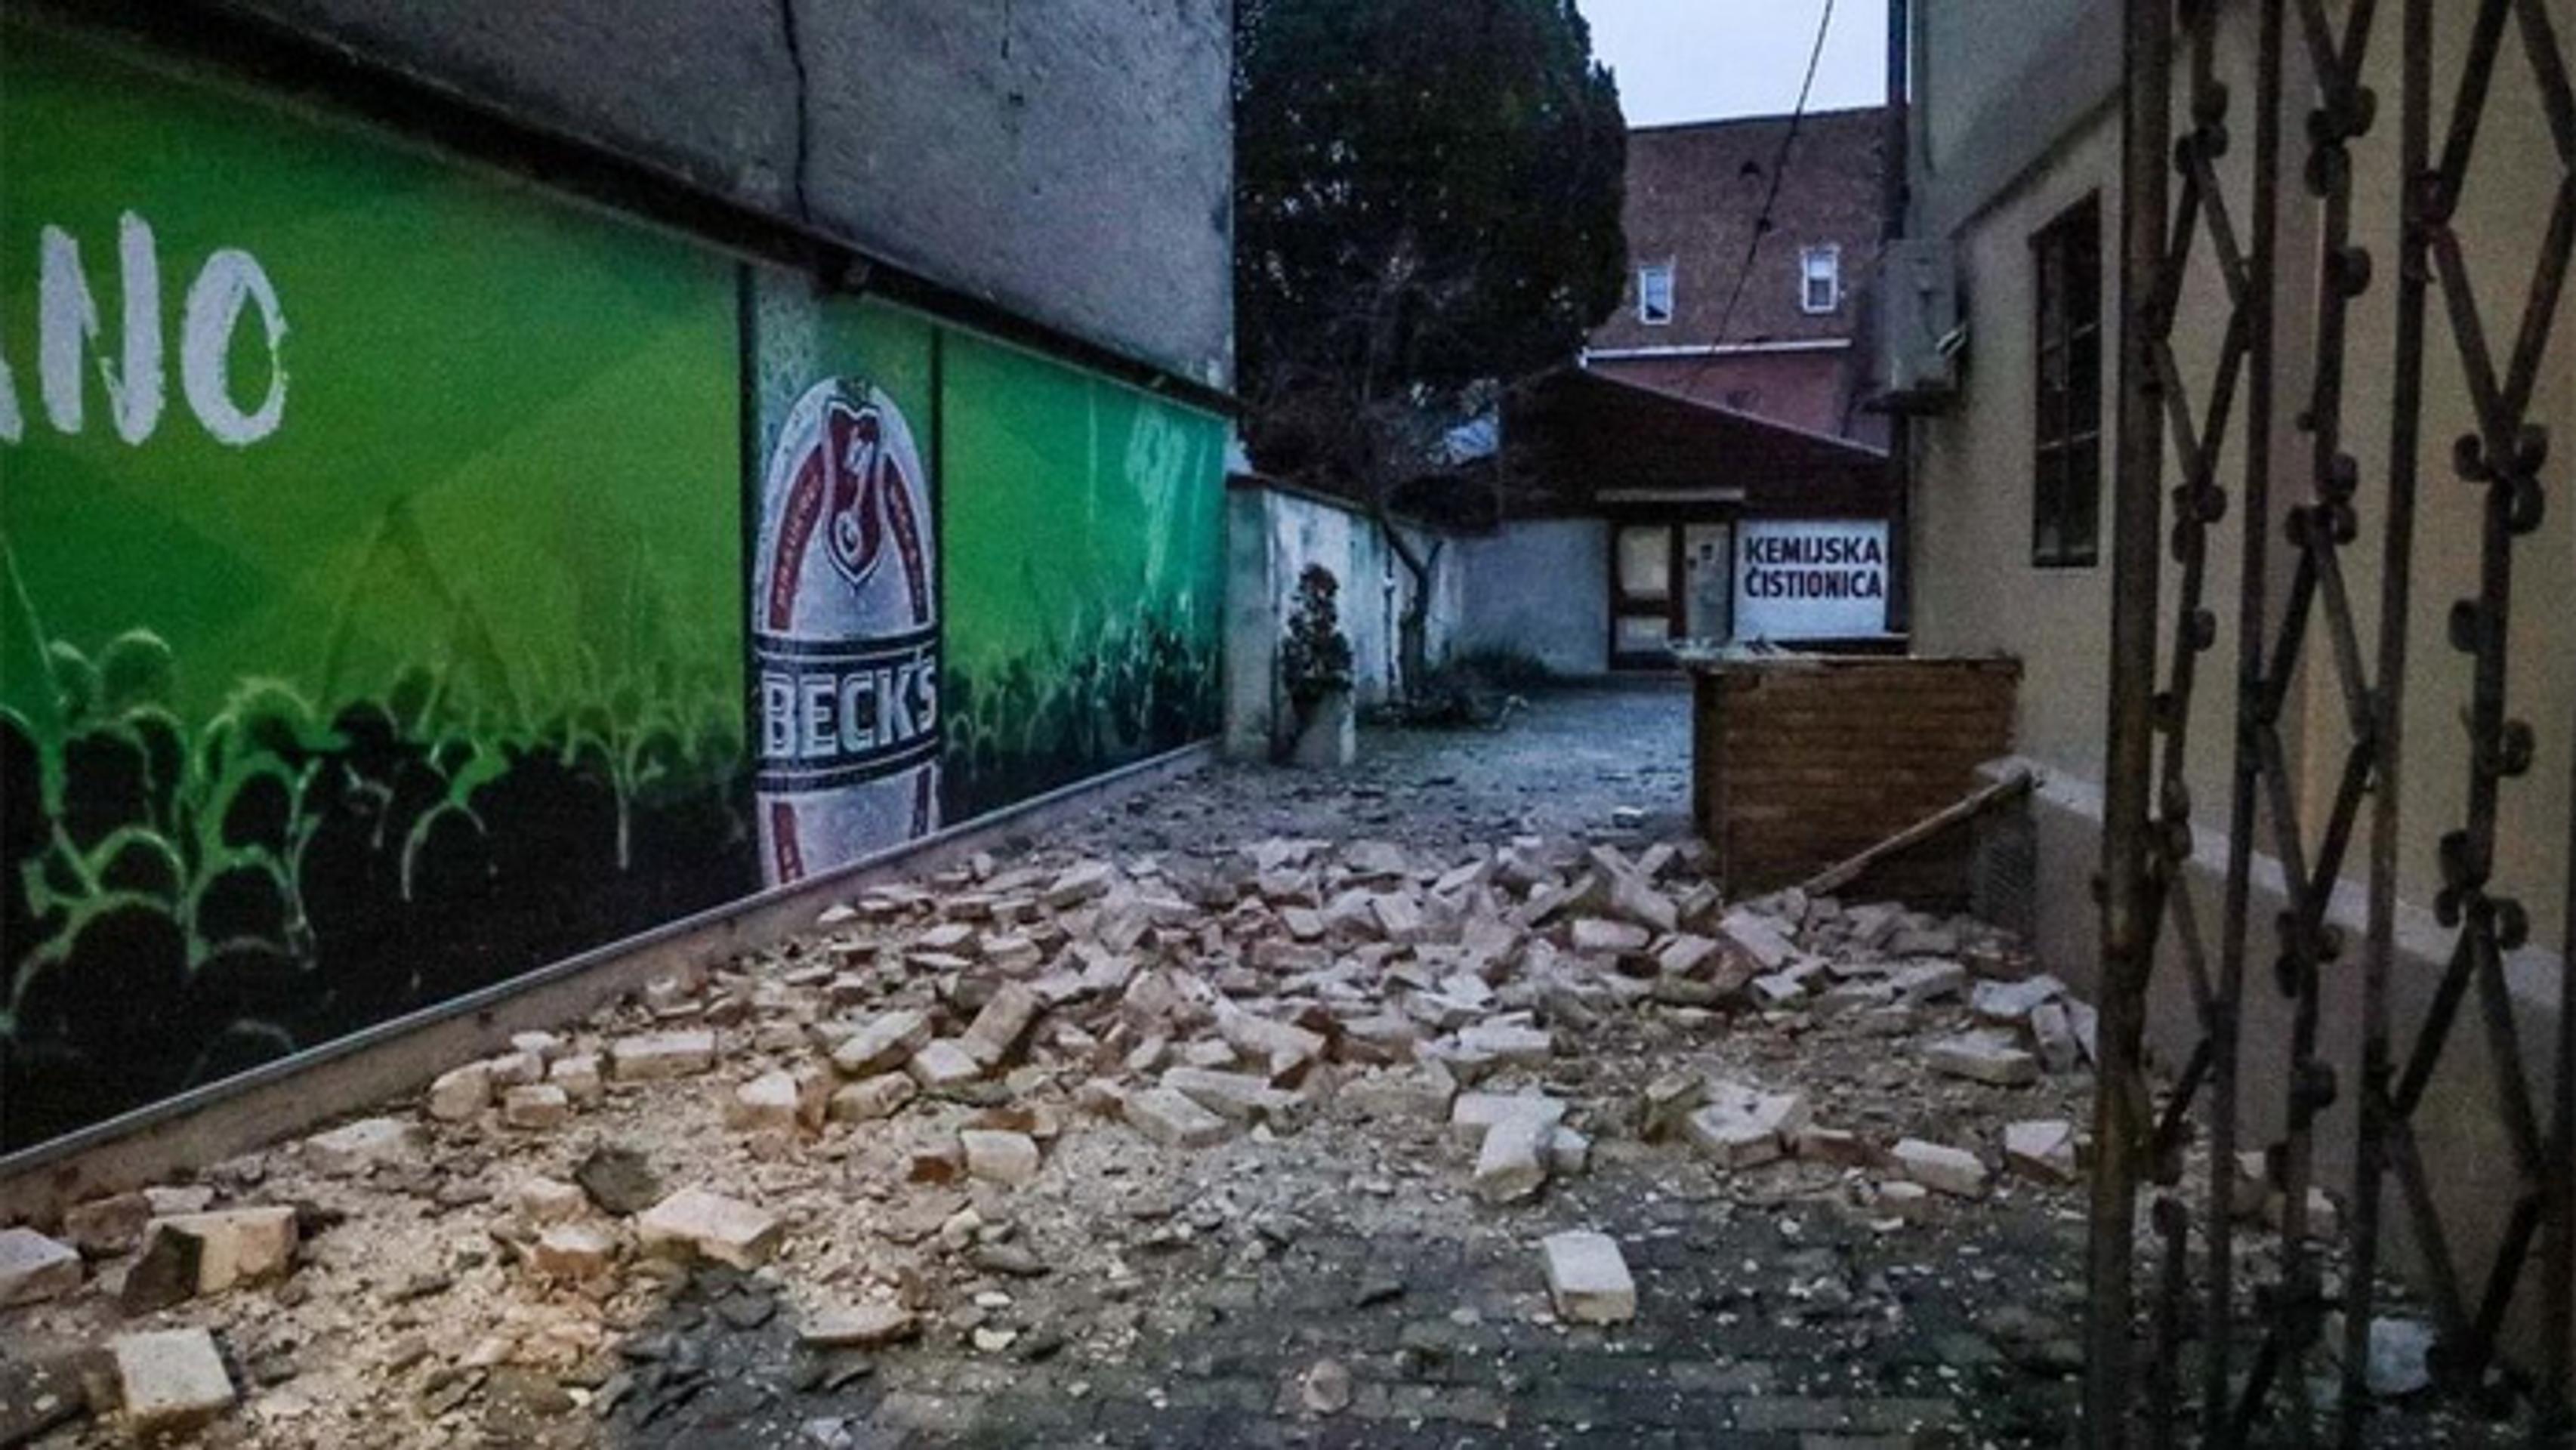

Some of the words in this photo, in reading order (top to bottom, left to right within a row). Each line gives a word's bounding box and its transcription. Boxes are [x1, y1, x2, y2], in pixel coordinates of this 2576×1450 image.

[1745, 537, 1882, 564] KEMIJSKA
[1745, 567, 1882, 598] ČISTIONICA
[761, 648, 937, 757] BECK'S
